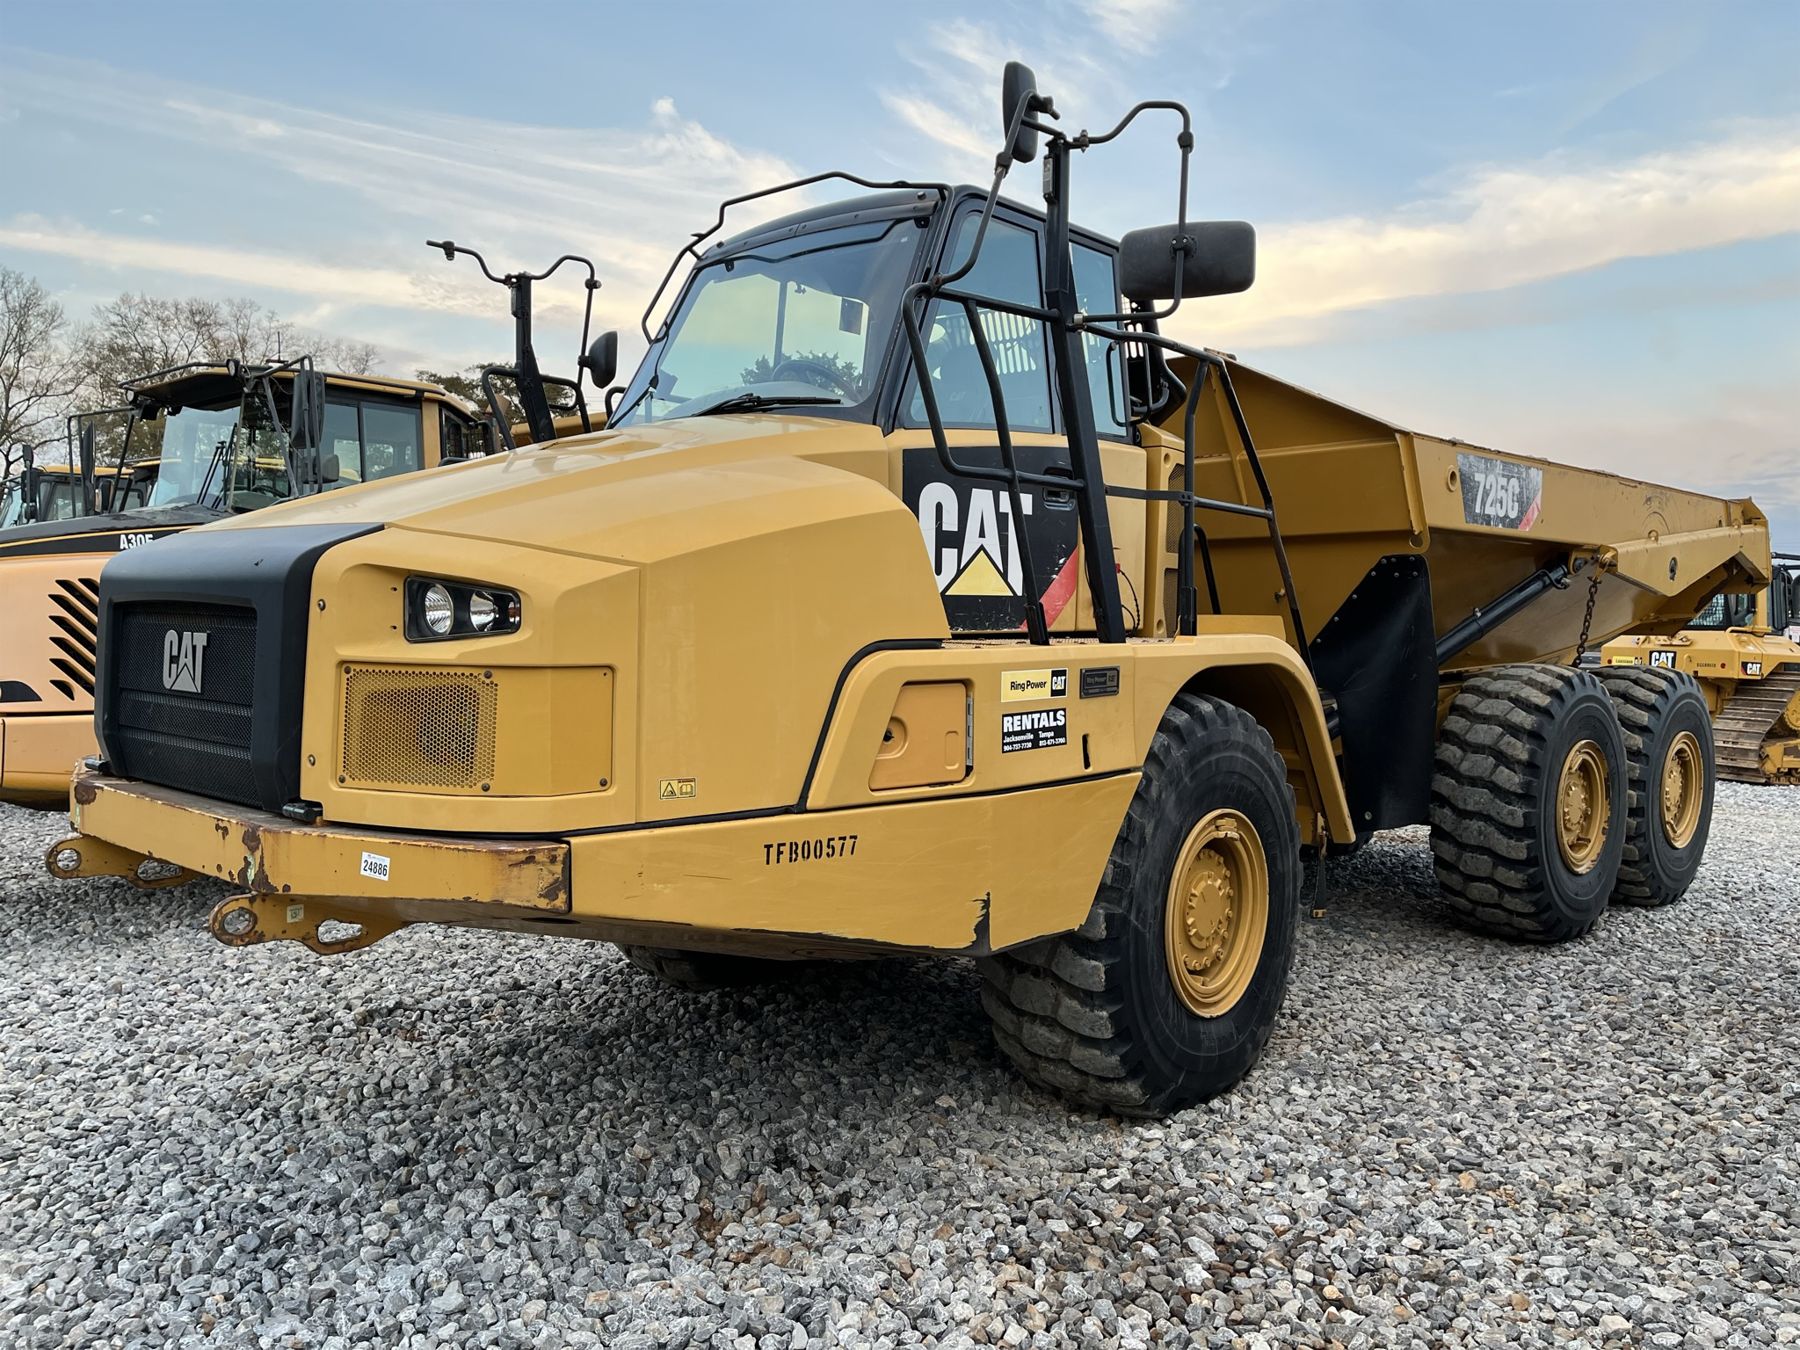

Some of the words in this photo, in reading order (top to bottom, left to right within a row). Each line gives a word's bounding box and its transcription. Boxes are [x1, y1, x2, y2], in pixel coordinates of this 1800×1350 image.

[1474, 472, 1520, 519] 725C
[918, 481, 1033, 597] CAT
[162, 629, 208, 693] CAT
[1651, 651, 1675, 668] CAT
[1746, 662, 1761, 675] CAT
[1010, 681, 1026, 692] Ring
[1026, 680, 1047, 690] Power
[1052, 676, 1066, 690] CAT
[1003, 710, 1065, 732] RENTALS
[1003, 733, 1034, 742] Jacksonville
[763, 835, 858, 865] TFB00577
[363, 859, 388, 877] 24886
